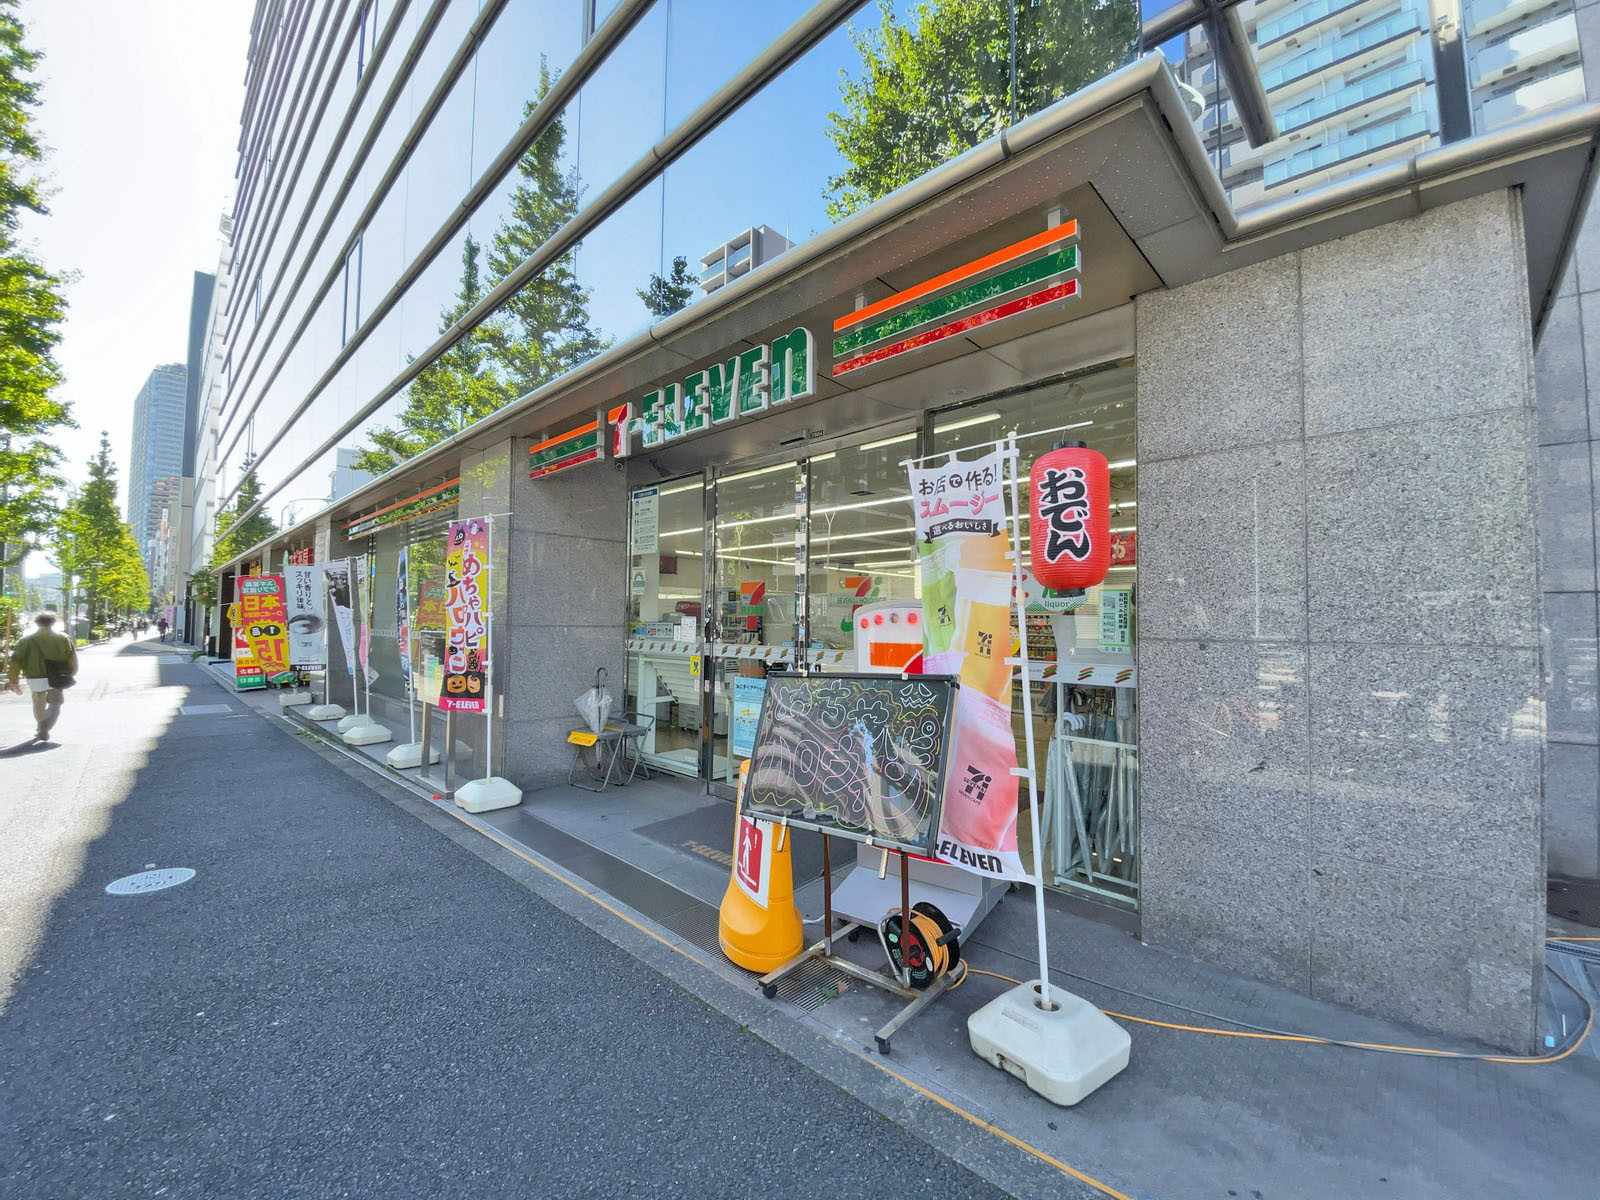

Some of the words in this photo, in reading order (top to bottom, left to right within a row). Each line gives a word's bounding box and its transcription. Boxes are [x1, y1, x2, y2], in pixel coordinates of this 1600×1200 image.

[918, 463, 998, 496] お店で作る!
[919, 490, 999, 519] スムージー
[1039, 469, 1091, 561] おでん
